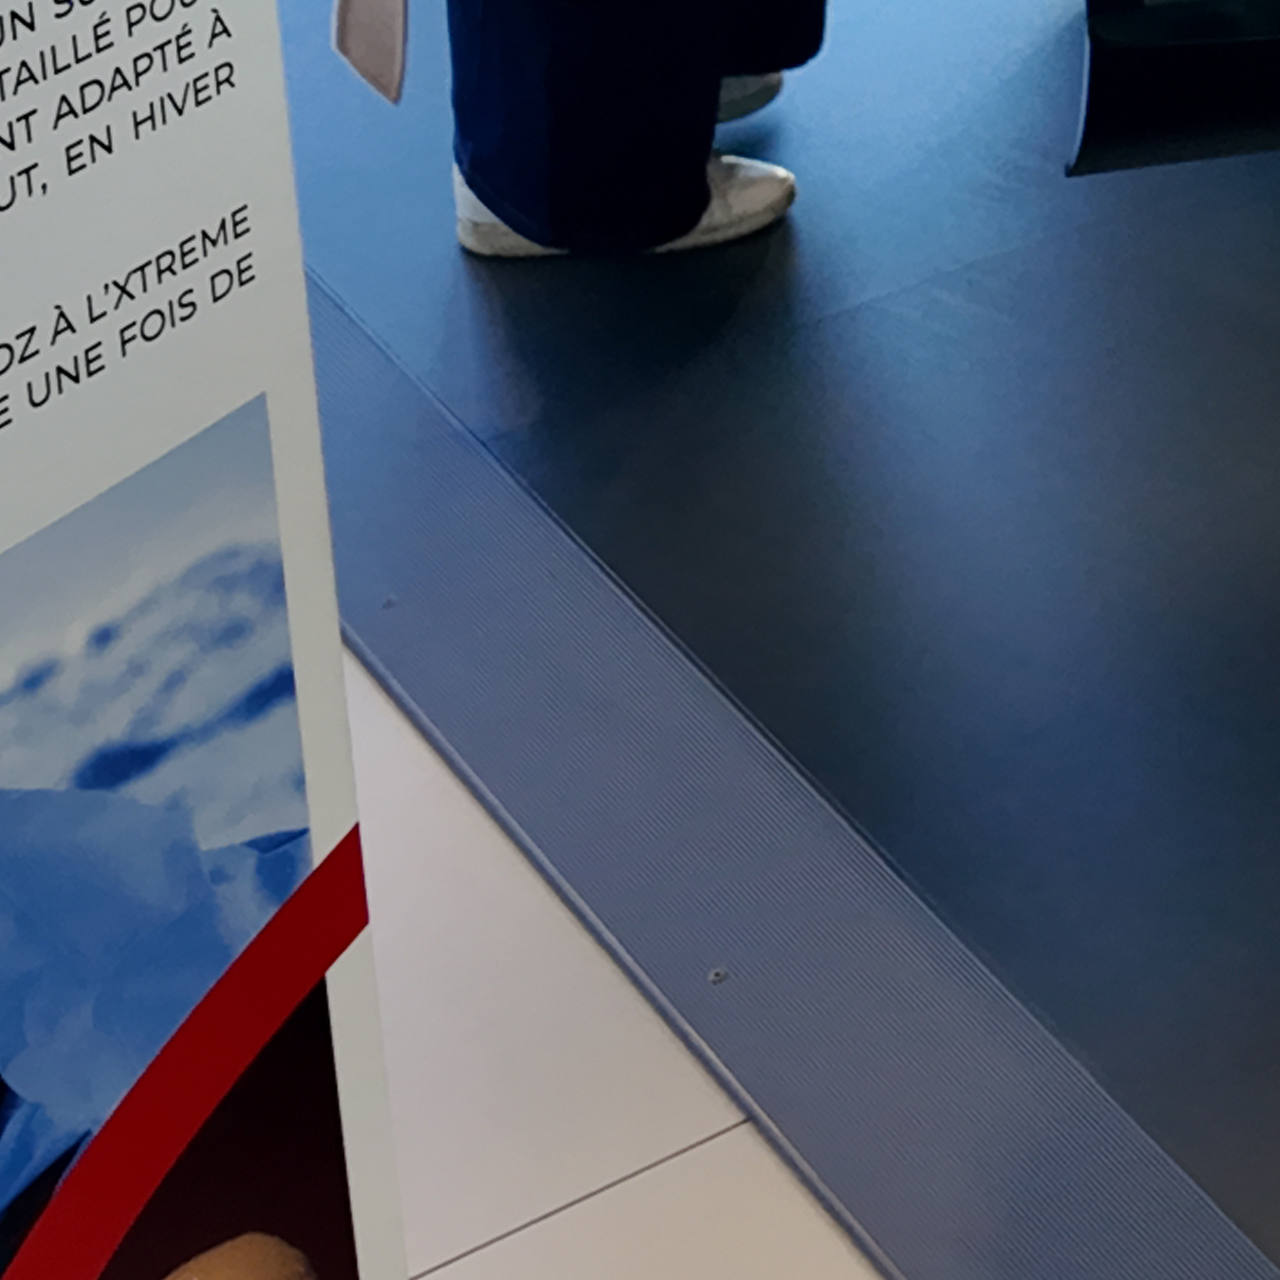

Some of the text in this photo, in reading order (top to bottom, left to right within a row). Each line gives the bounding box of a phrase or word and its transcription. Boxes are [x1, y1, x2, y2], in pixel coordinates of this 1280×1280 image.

[0, 1, 35, 46] N
[53, 22, 195, 130] ADAPTÉ
[208, 8, 232, 49] À
[65, 125, 113, 176] EN
[132, 61, 236, 140] HIVER
[27, 340, 106, 408] UNE
[119, 288, 197, 358] FOIS
[210, 252, 256, 304] DE
[50, 304, 77, 347] À
[86, 203, 251, 324] L'XTREME
